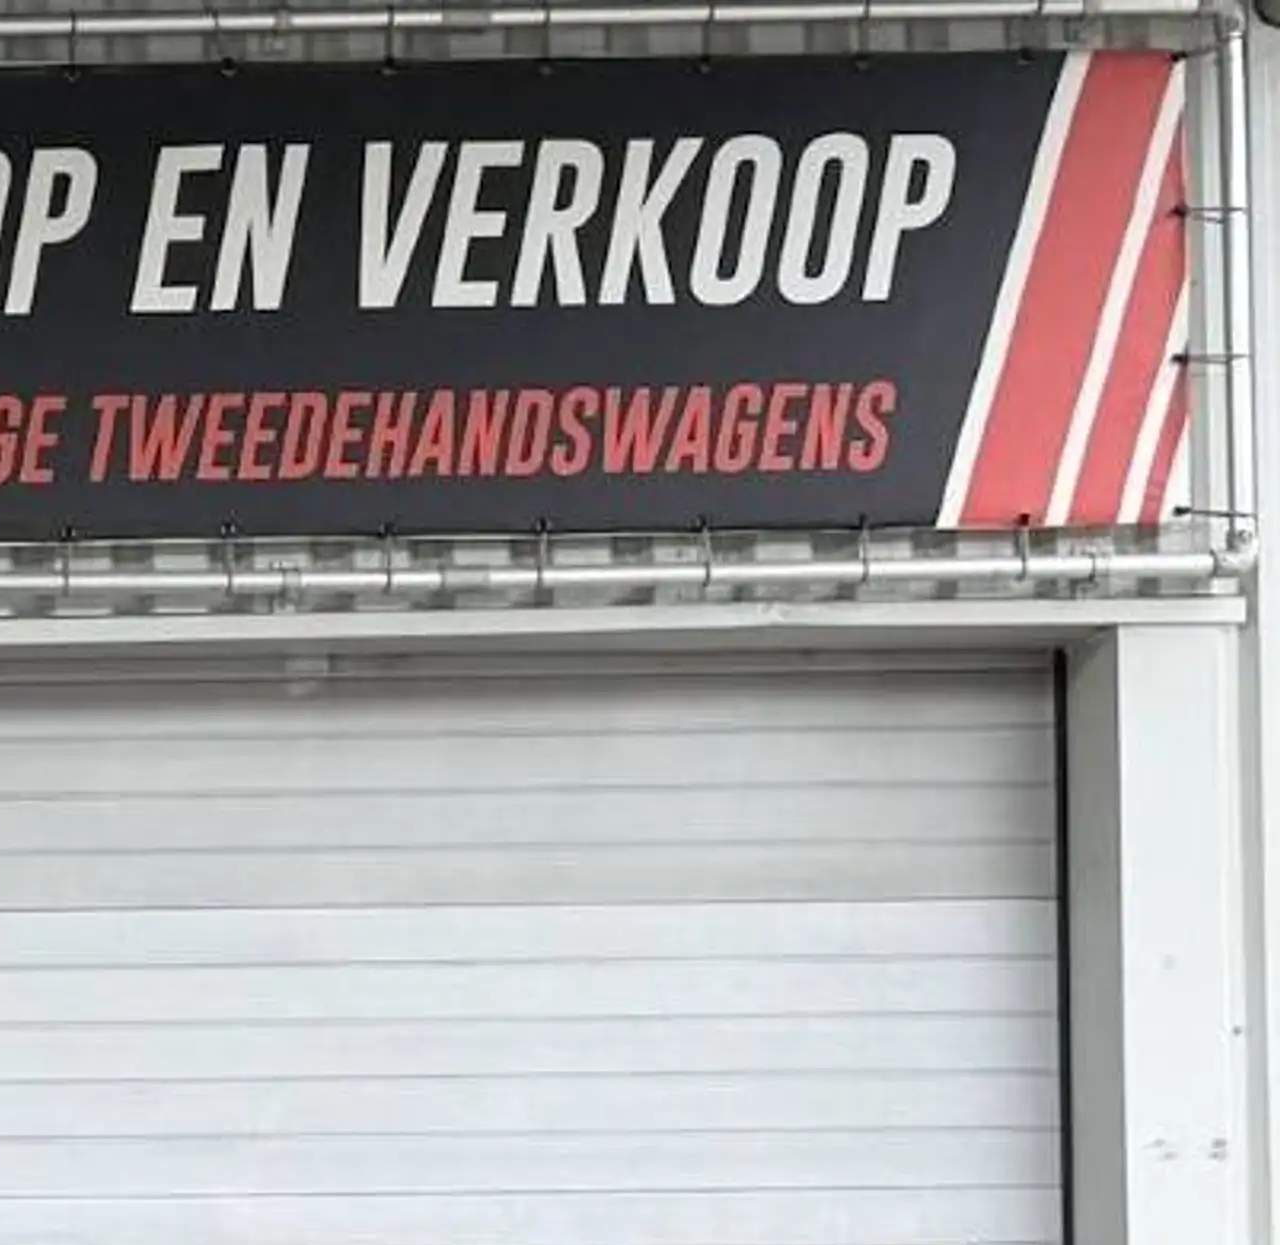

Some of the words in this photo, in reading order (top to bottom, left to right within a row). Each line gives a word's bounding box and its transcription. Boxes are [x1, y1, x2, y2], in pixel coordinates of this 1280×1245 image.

[130, 144, 309, 313] EN
[359, 133, 956, 308] VERKOOP
[90, 380, 896, 481] TWEEDEHANDSWAGENS
